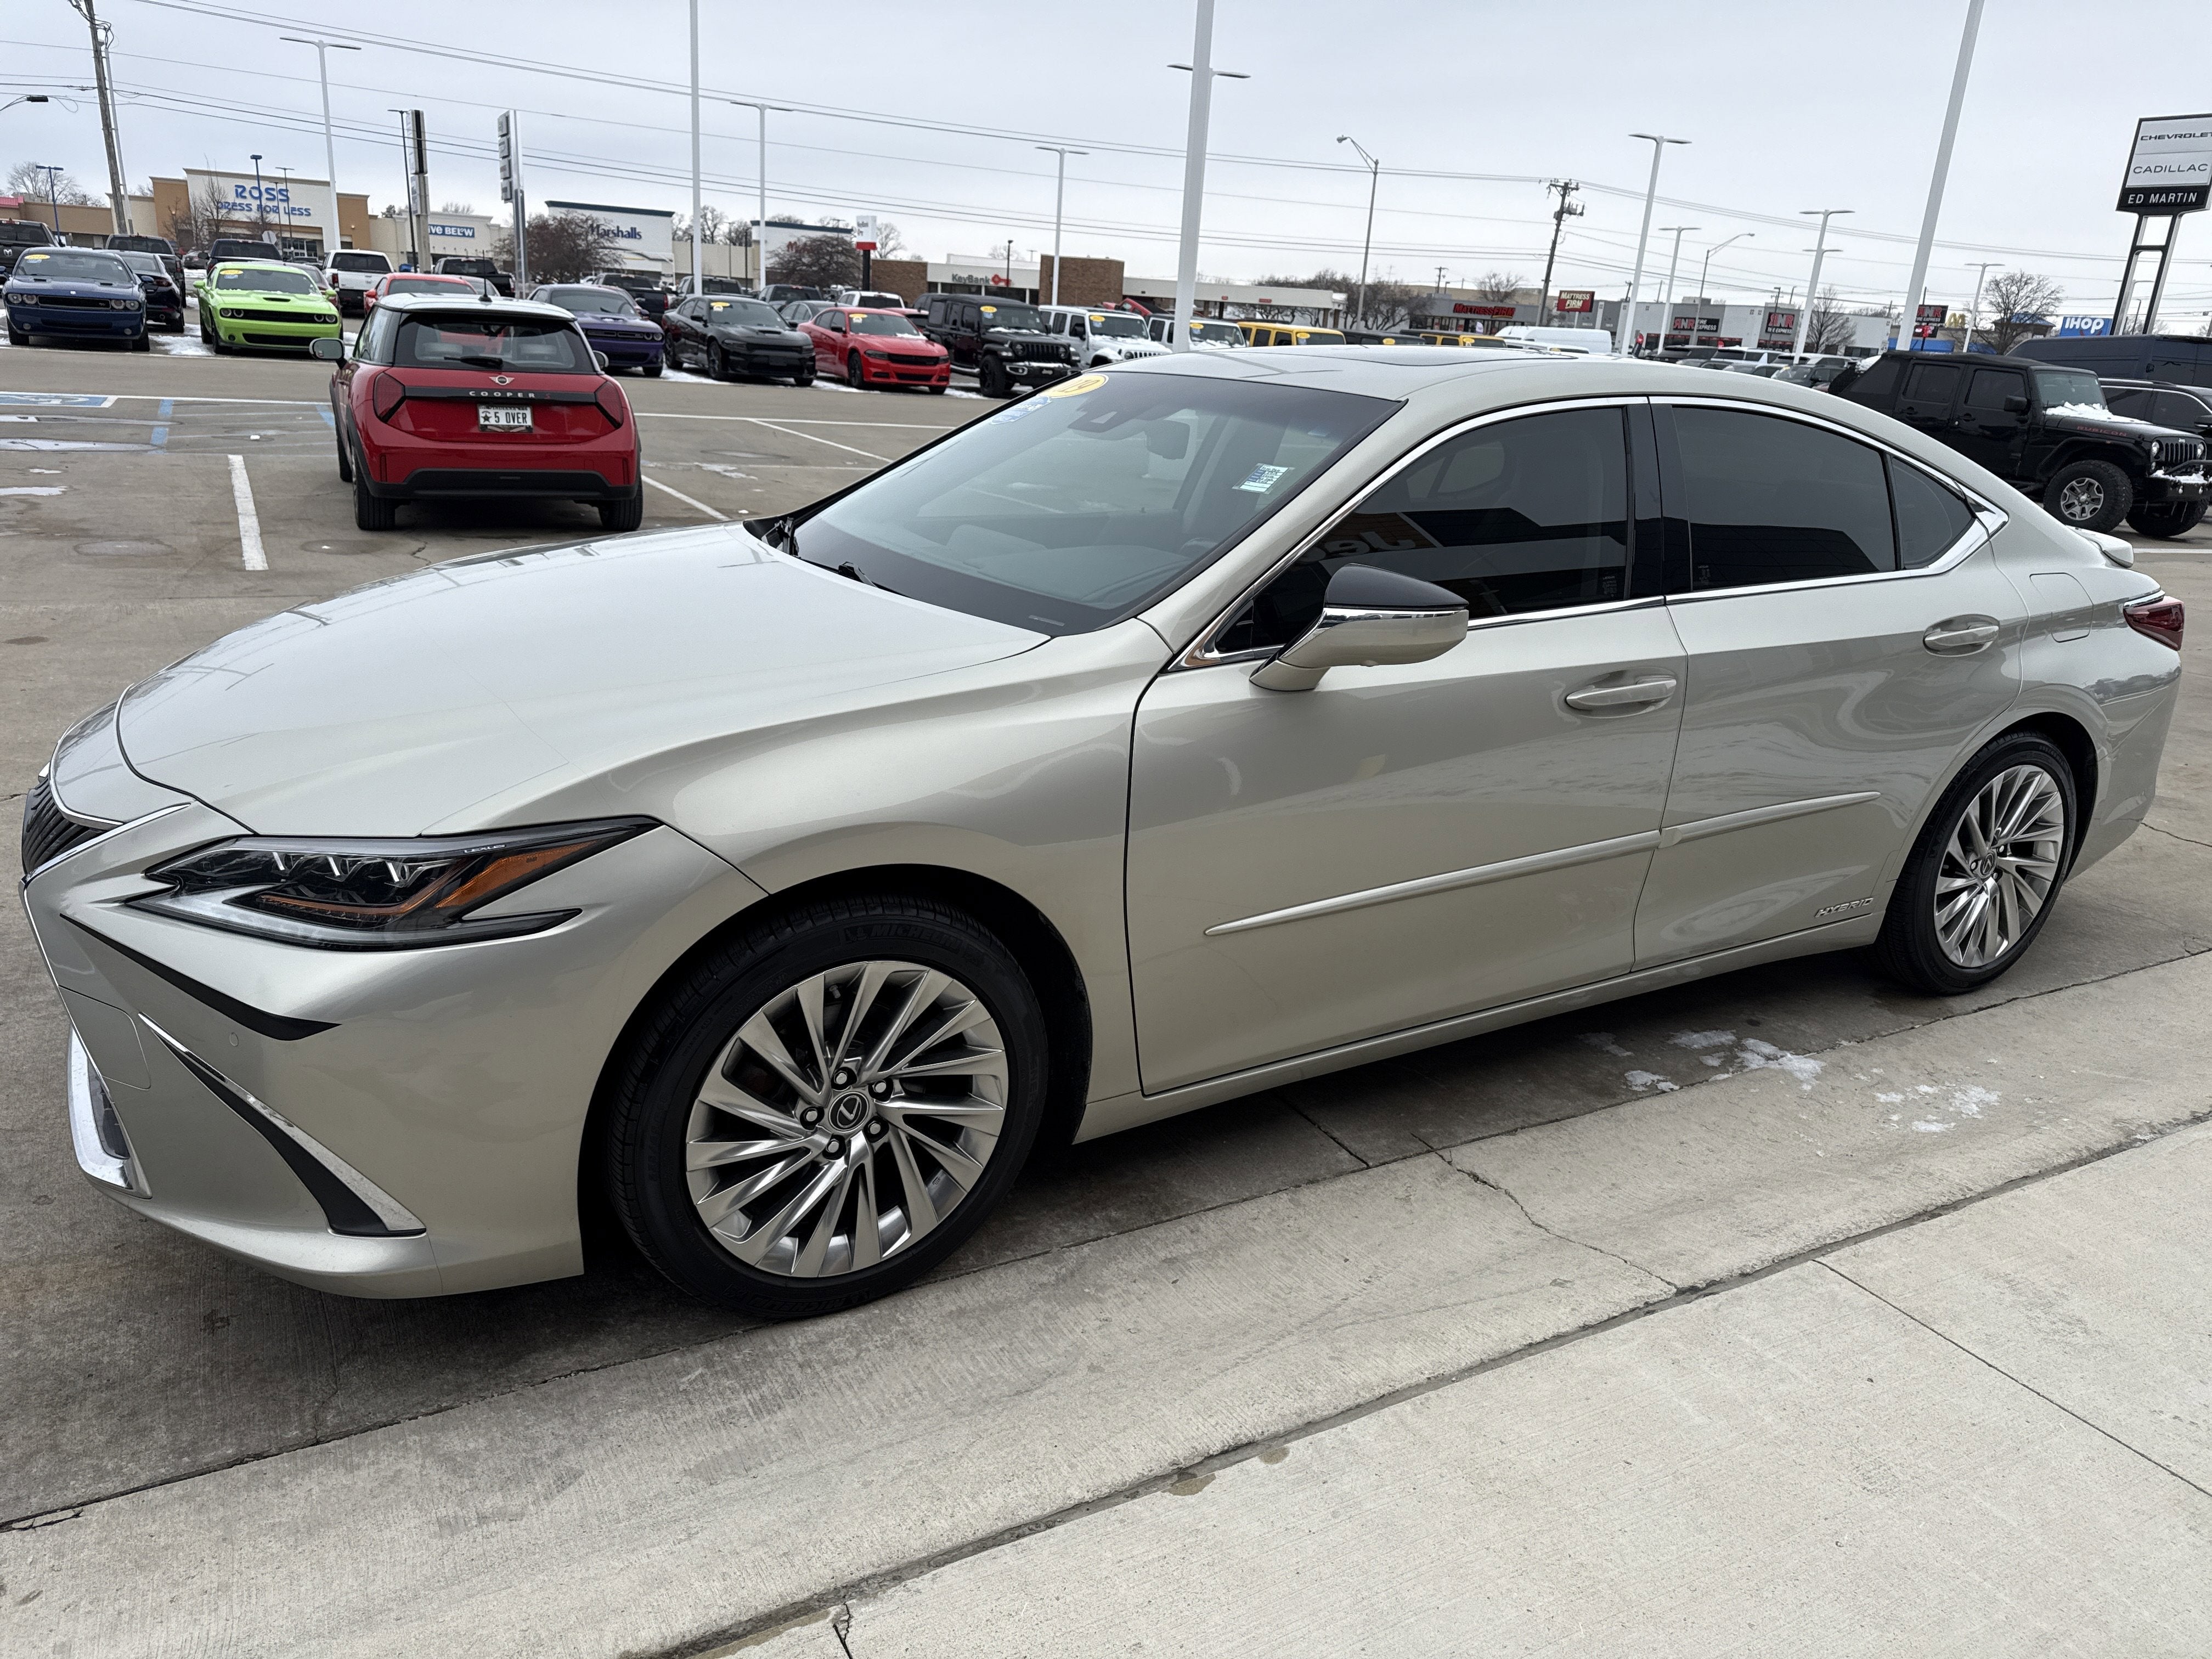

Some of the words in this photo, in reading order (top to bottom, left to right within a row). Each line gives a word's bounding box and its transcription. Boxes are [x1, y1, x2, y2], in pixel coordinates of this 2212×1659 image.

[2133, 163, 2208, 174] CADILLAC
[234, 184, 290, 202] ROSS
[2128, 194, 2144, 204] ED
[2149, 193, 2198, 204] MARTIN
[219, 201, 252, 212] DRESS
[257, 204, 280, 214] FOR
[284, 206, 311, 216] LESS
[952, 273, 990, 285] KeyBank
[1561, 292, 1590, 300] MATTRESS
[1565, 299, 1583, 308] FIRM
[1453, 303, 1493, 315] MATTRESS
[1493, 306, 1515, 317] FIRM
[2064, 317, 2104, 334] IHOP
[494, 411, 500, 424] 5
[505, 412, 528, 424] OVER
[2077, 425, 2127, 437] RUBICON
[464, 845, 505, 853] LEXUS
[1814, 897, 1874, 918] HYBRID
[870, 923, 962, 952] MICHELIN
